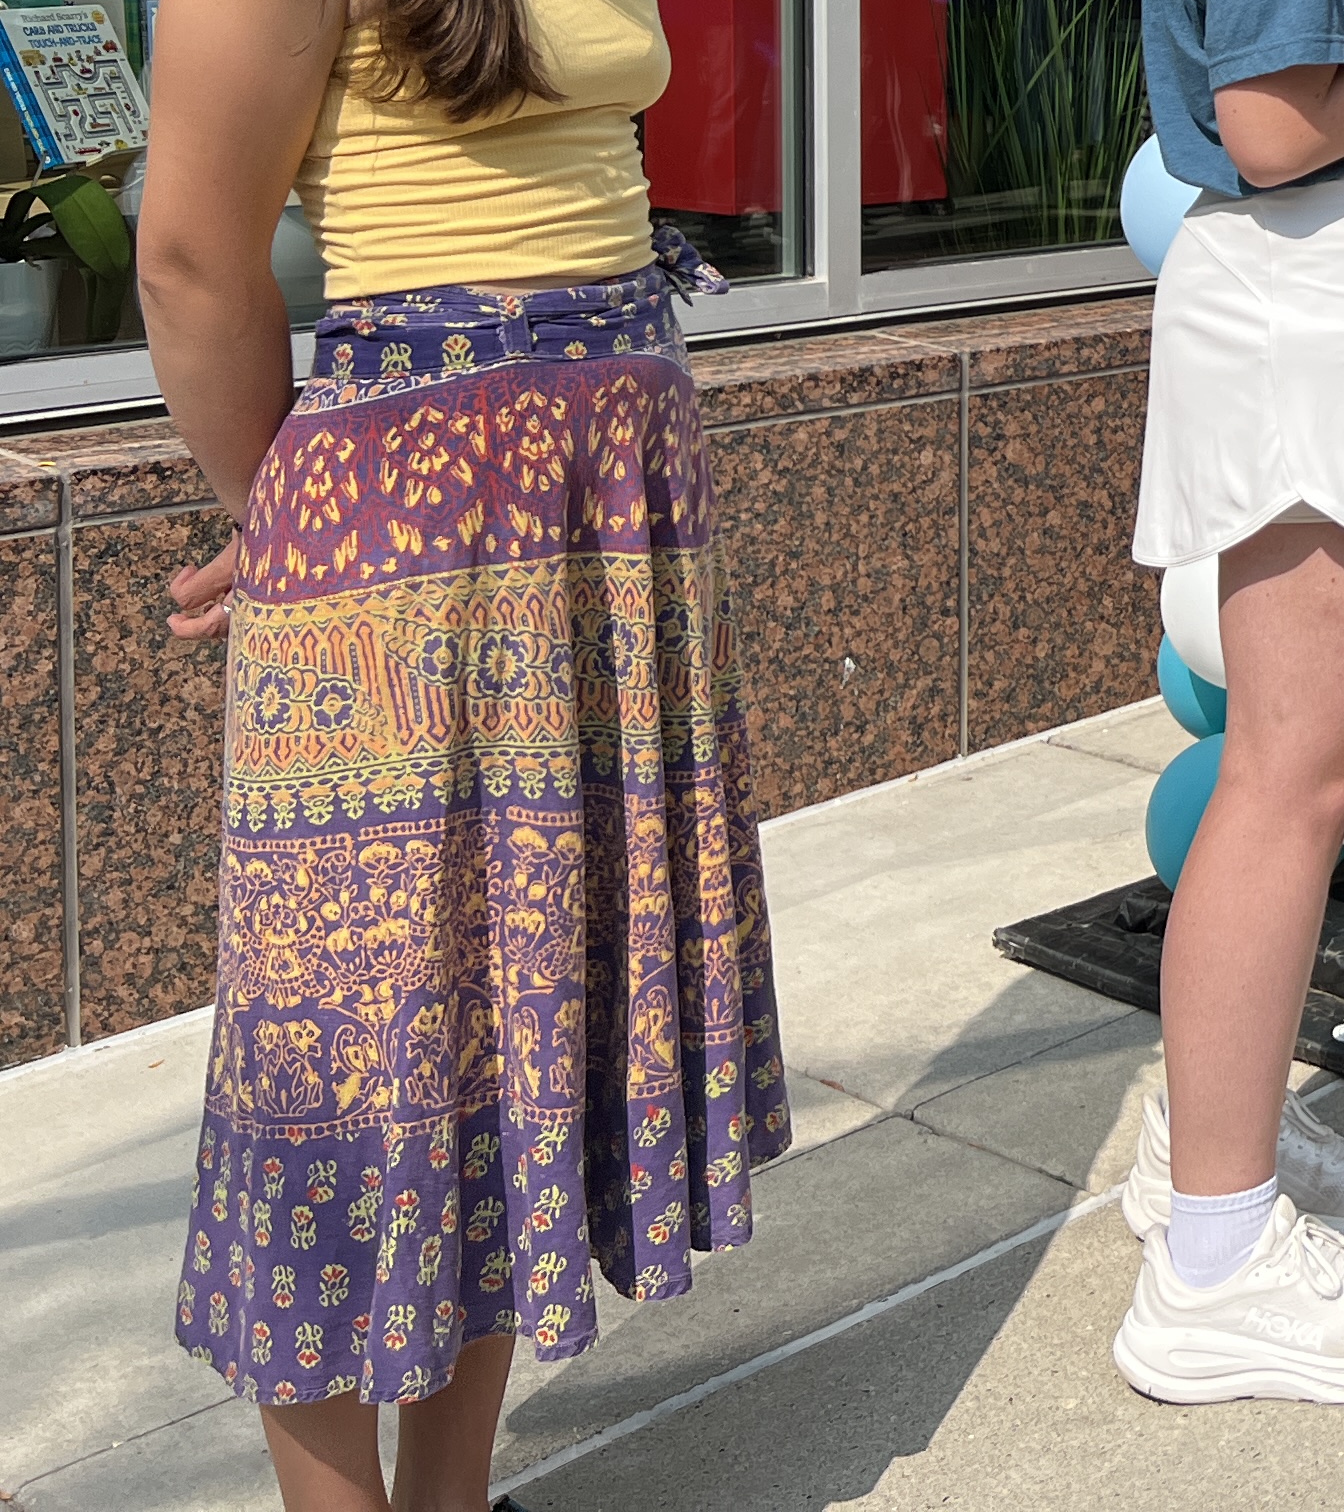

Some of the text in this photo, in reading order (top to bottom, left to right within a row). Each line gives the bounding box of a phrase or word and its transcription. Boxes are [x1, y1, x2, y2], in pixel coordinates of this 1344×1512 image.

[21, 13, 56, 23] Richard
[47, 24, 64, 35] AND
[1239, 1307, 1325, 1352] HOKA
